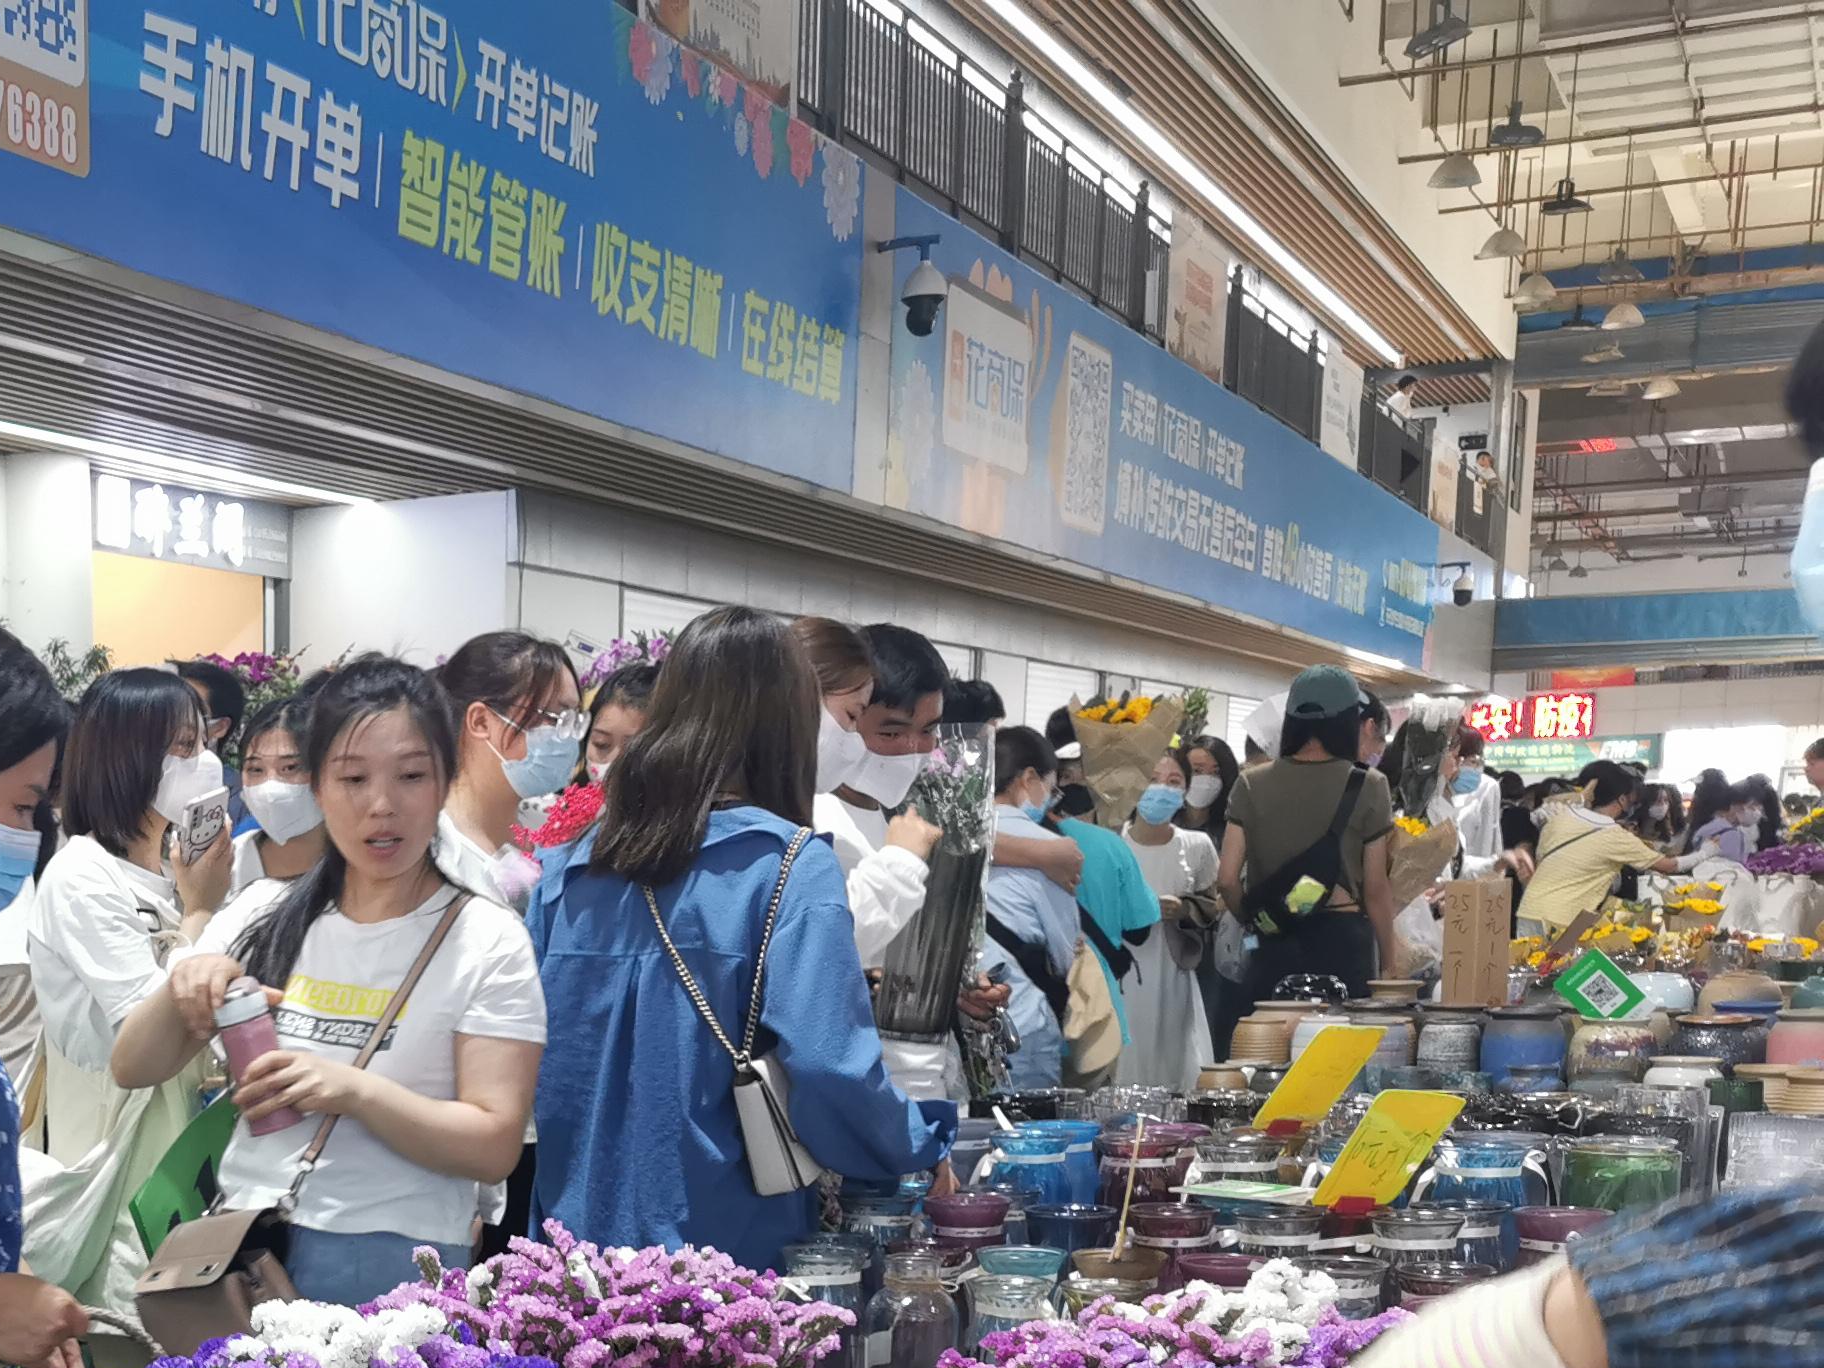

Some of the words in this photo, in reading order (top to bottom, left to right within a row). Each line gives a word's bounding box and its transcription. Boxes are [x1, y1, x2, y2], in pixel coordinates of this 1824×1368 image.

[139, 9, 362, 208] 手机开单
[397, 128, 568, 299] 智能管账
[590, 219, 723, 360] 收支清晰
[741, 289, 845, 404] 在线结算
[966, 335, 1025, 426] 花商保
